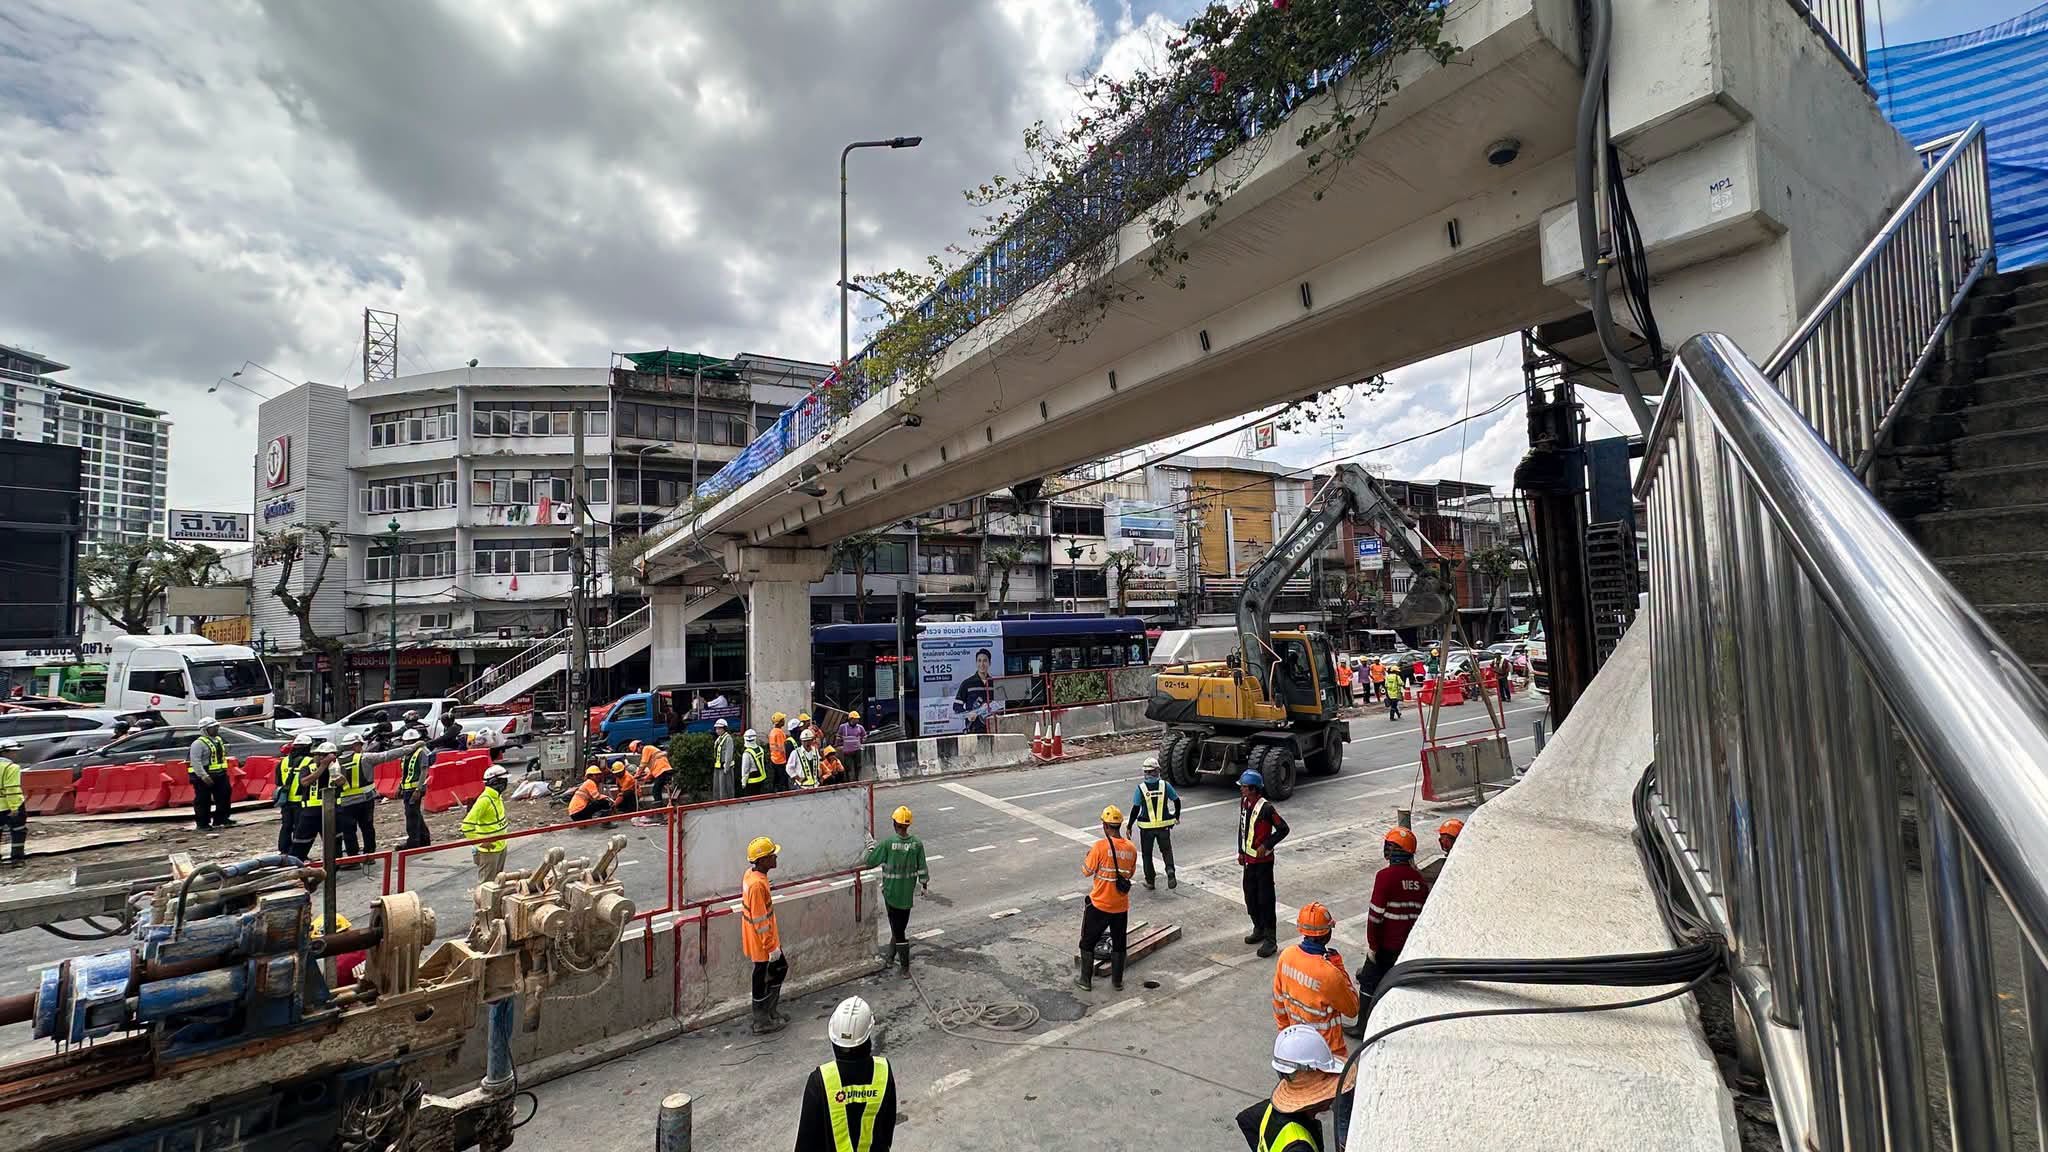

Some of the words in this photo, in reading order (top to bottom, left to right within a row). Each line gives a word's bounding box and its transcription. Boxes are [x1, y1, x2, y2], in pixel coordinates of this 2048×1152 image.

[1709, 177, 1733, 194] MP1
[1285, 521, 1325, 560] VOLVO
[931, 664, 952, 674] 1125
[1164, 680, 1189, 689] 02-154
[1402, 879, 1421, 891] UES
[1281, 962, 1323, 993] UNIQUE
